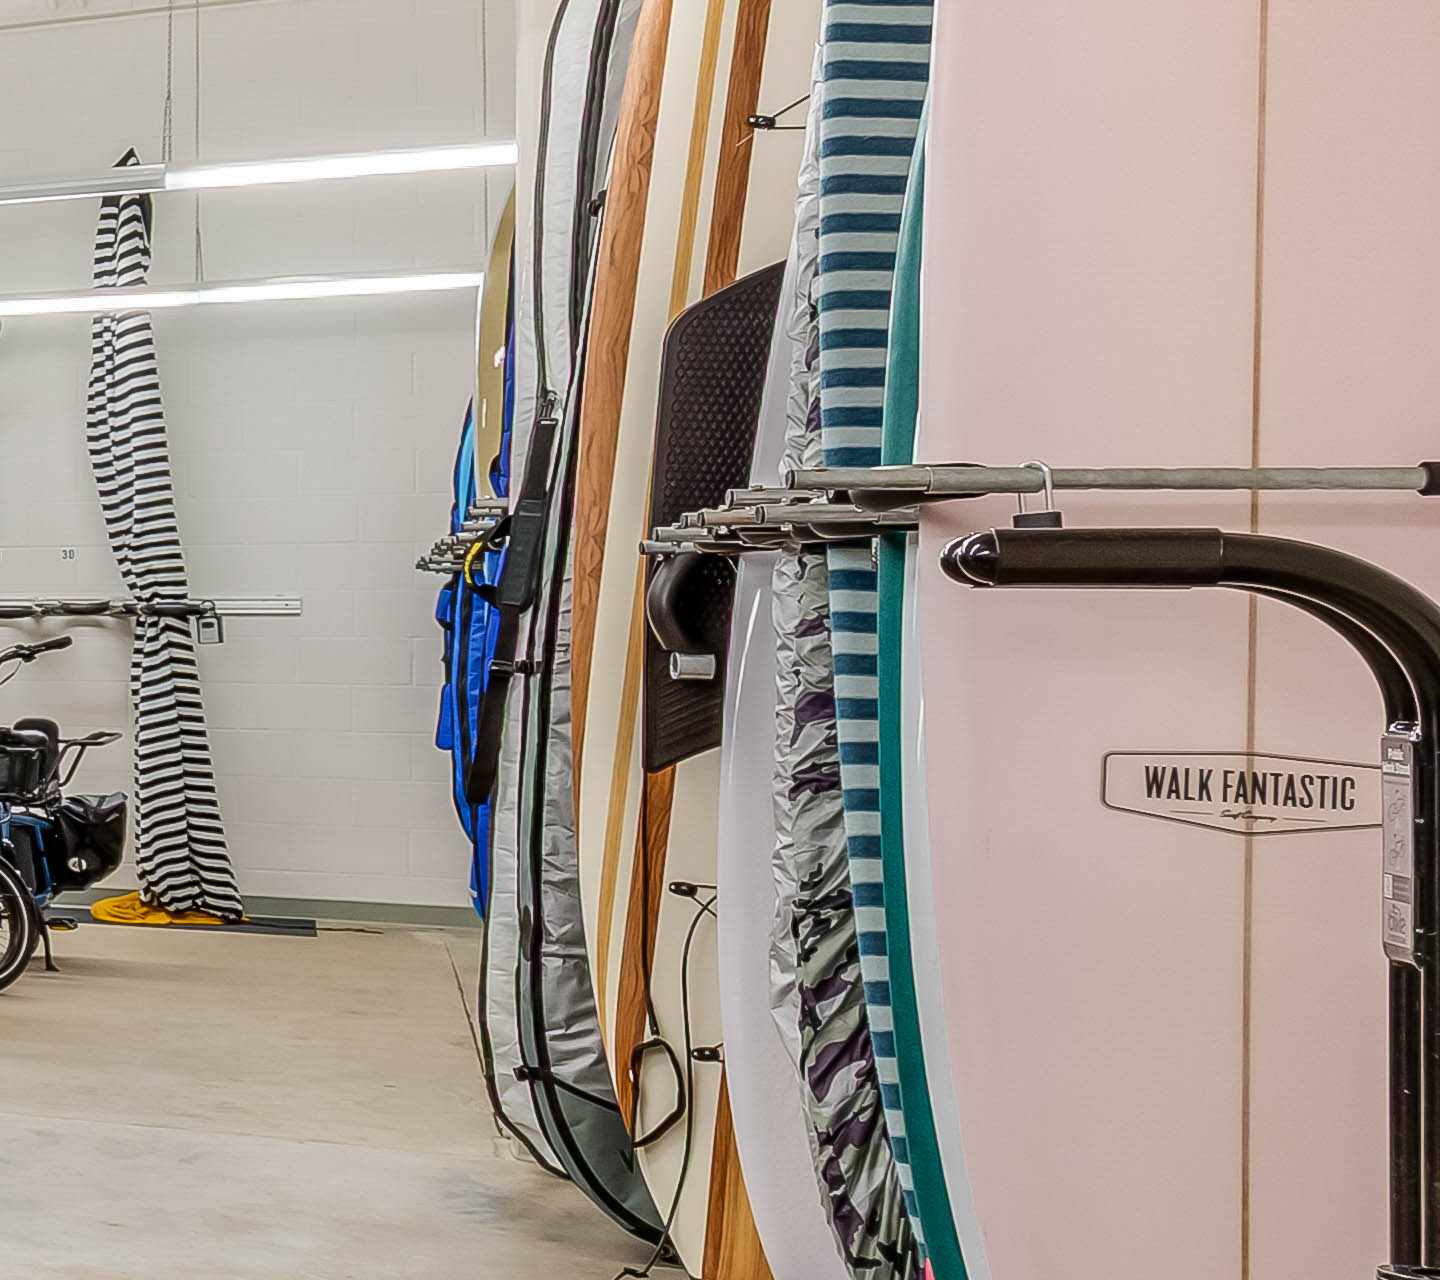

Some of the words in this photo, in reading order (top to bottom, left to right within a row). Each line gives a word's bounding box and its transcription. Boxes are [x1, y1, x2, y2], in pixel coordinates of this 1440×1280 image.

[61, 549, 76, 561] 30
[1143, 764, 1214, 803] WALK
[1221, 769, 1356, 812] FANTASTIC
